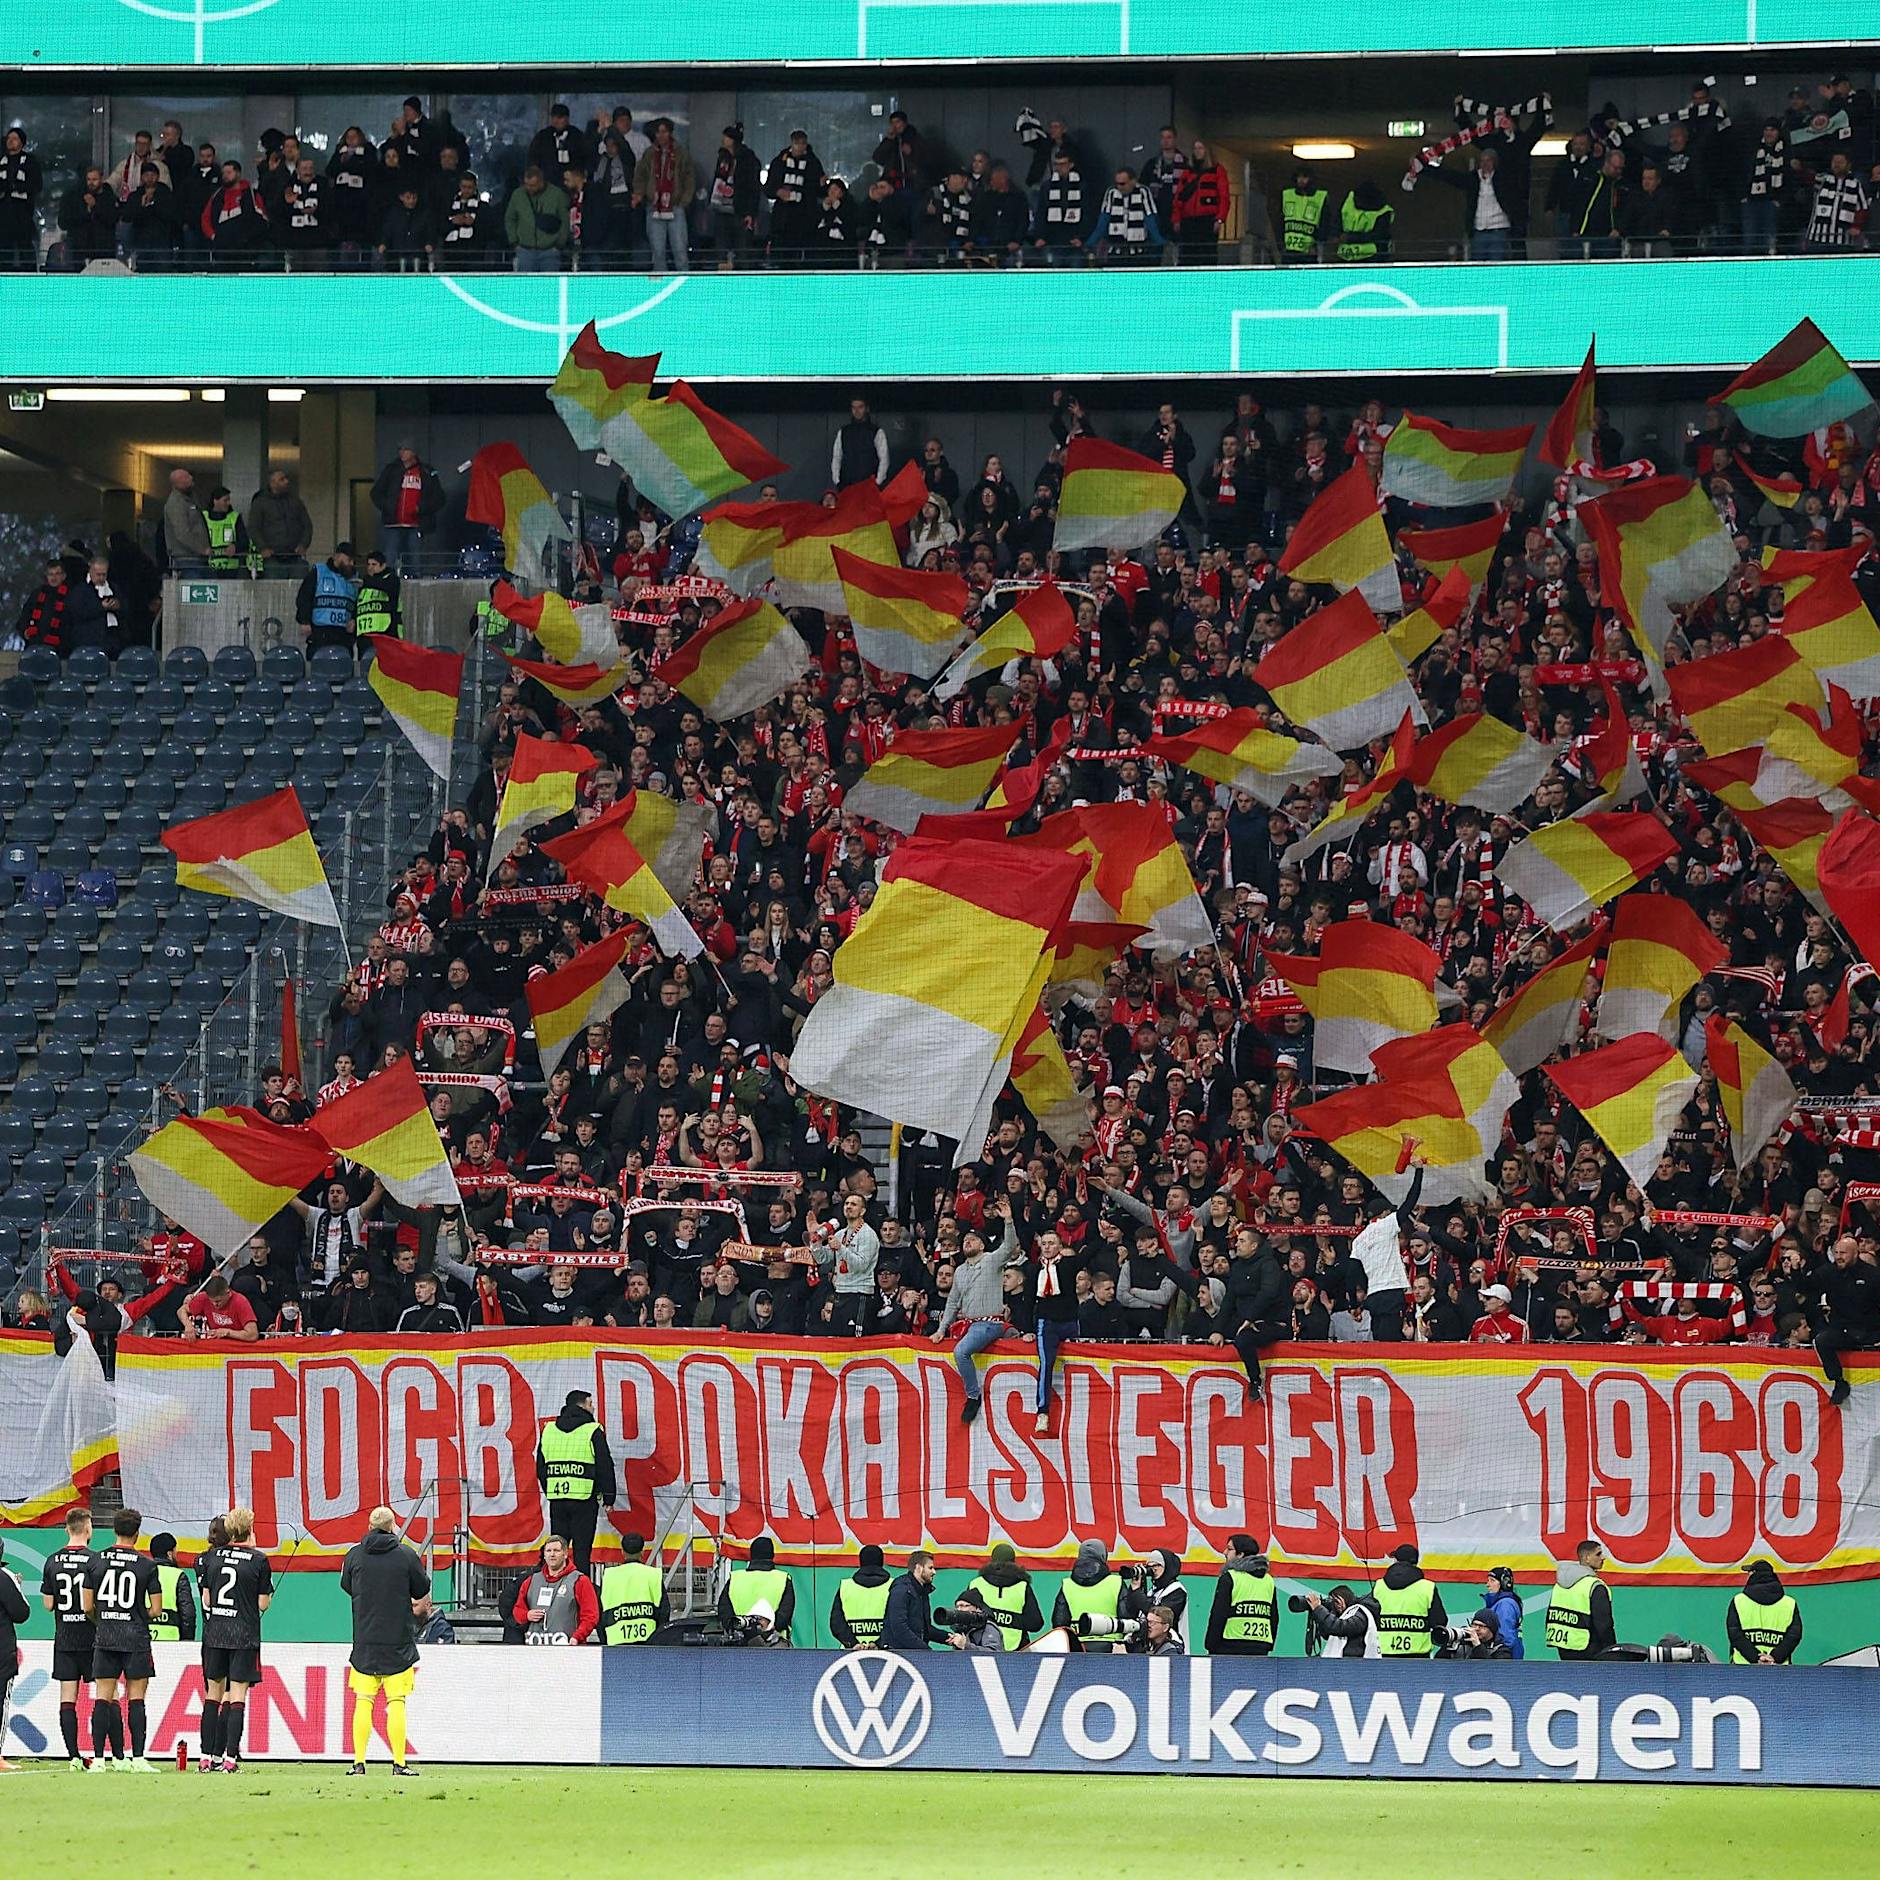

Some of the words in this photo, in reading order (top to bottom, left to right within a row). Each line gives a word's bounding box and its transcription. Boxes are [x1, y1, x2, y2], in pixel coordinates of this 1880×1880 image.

[1161, 702, 1228, 718] NIONER
[423, 1011, 472, 1026] EISERN
[473, 1015, 509, 1029] UNIO
[437, 1073, 480, 1084] UNION
[481, 1250, 531, 1263] EAST
[553, 1254, 620, 1265] DEVILS
[1517, 1368, 1844, 1566] 1968
[116, 1552, 139, 1562] UNION
[232, 1551, 253, 1561] UNION
[56, 1572, 85, 1612] 31
[97, 1569, 137, 1609] 40
[217, 1566, 237, 1606] 2
[614, 1604, 654, 1621] STEWARD
[1235, 1604, 1272, 1617] STEWAR
[1548, 1608, 1579, 1625] TEWARD
[1243, 1621, 1270, 1639] 2236
[1380, 1615, 1425, 1630] STEWARD
[620, 1623, 648, 1640] 1736
[972, 1655, 1762, 1783] Volkswagen
